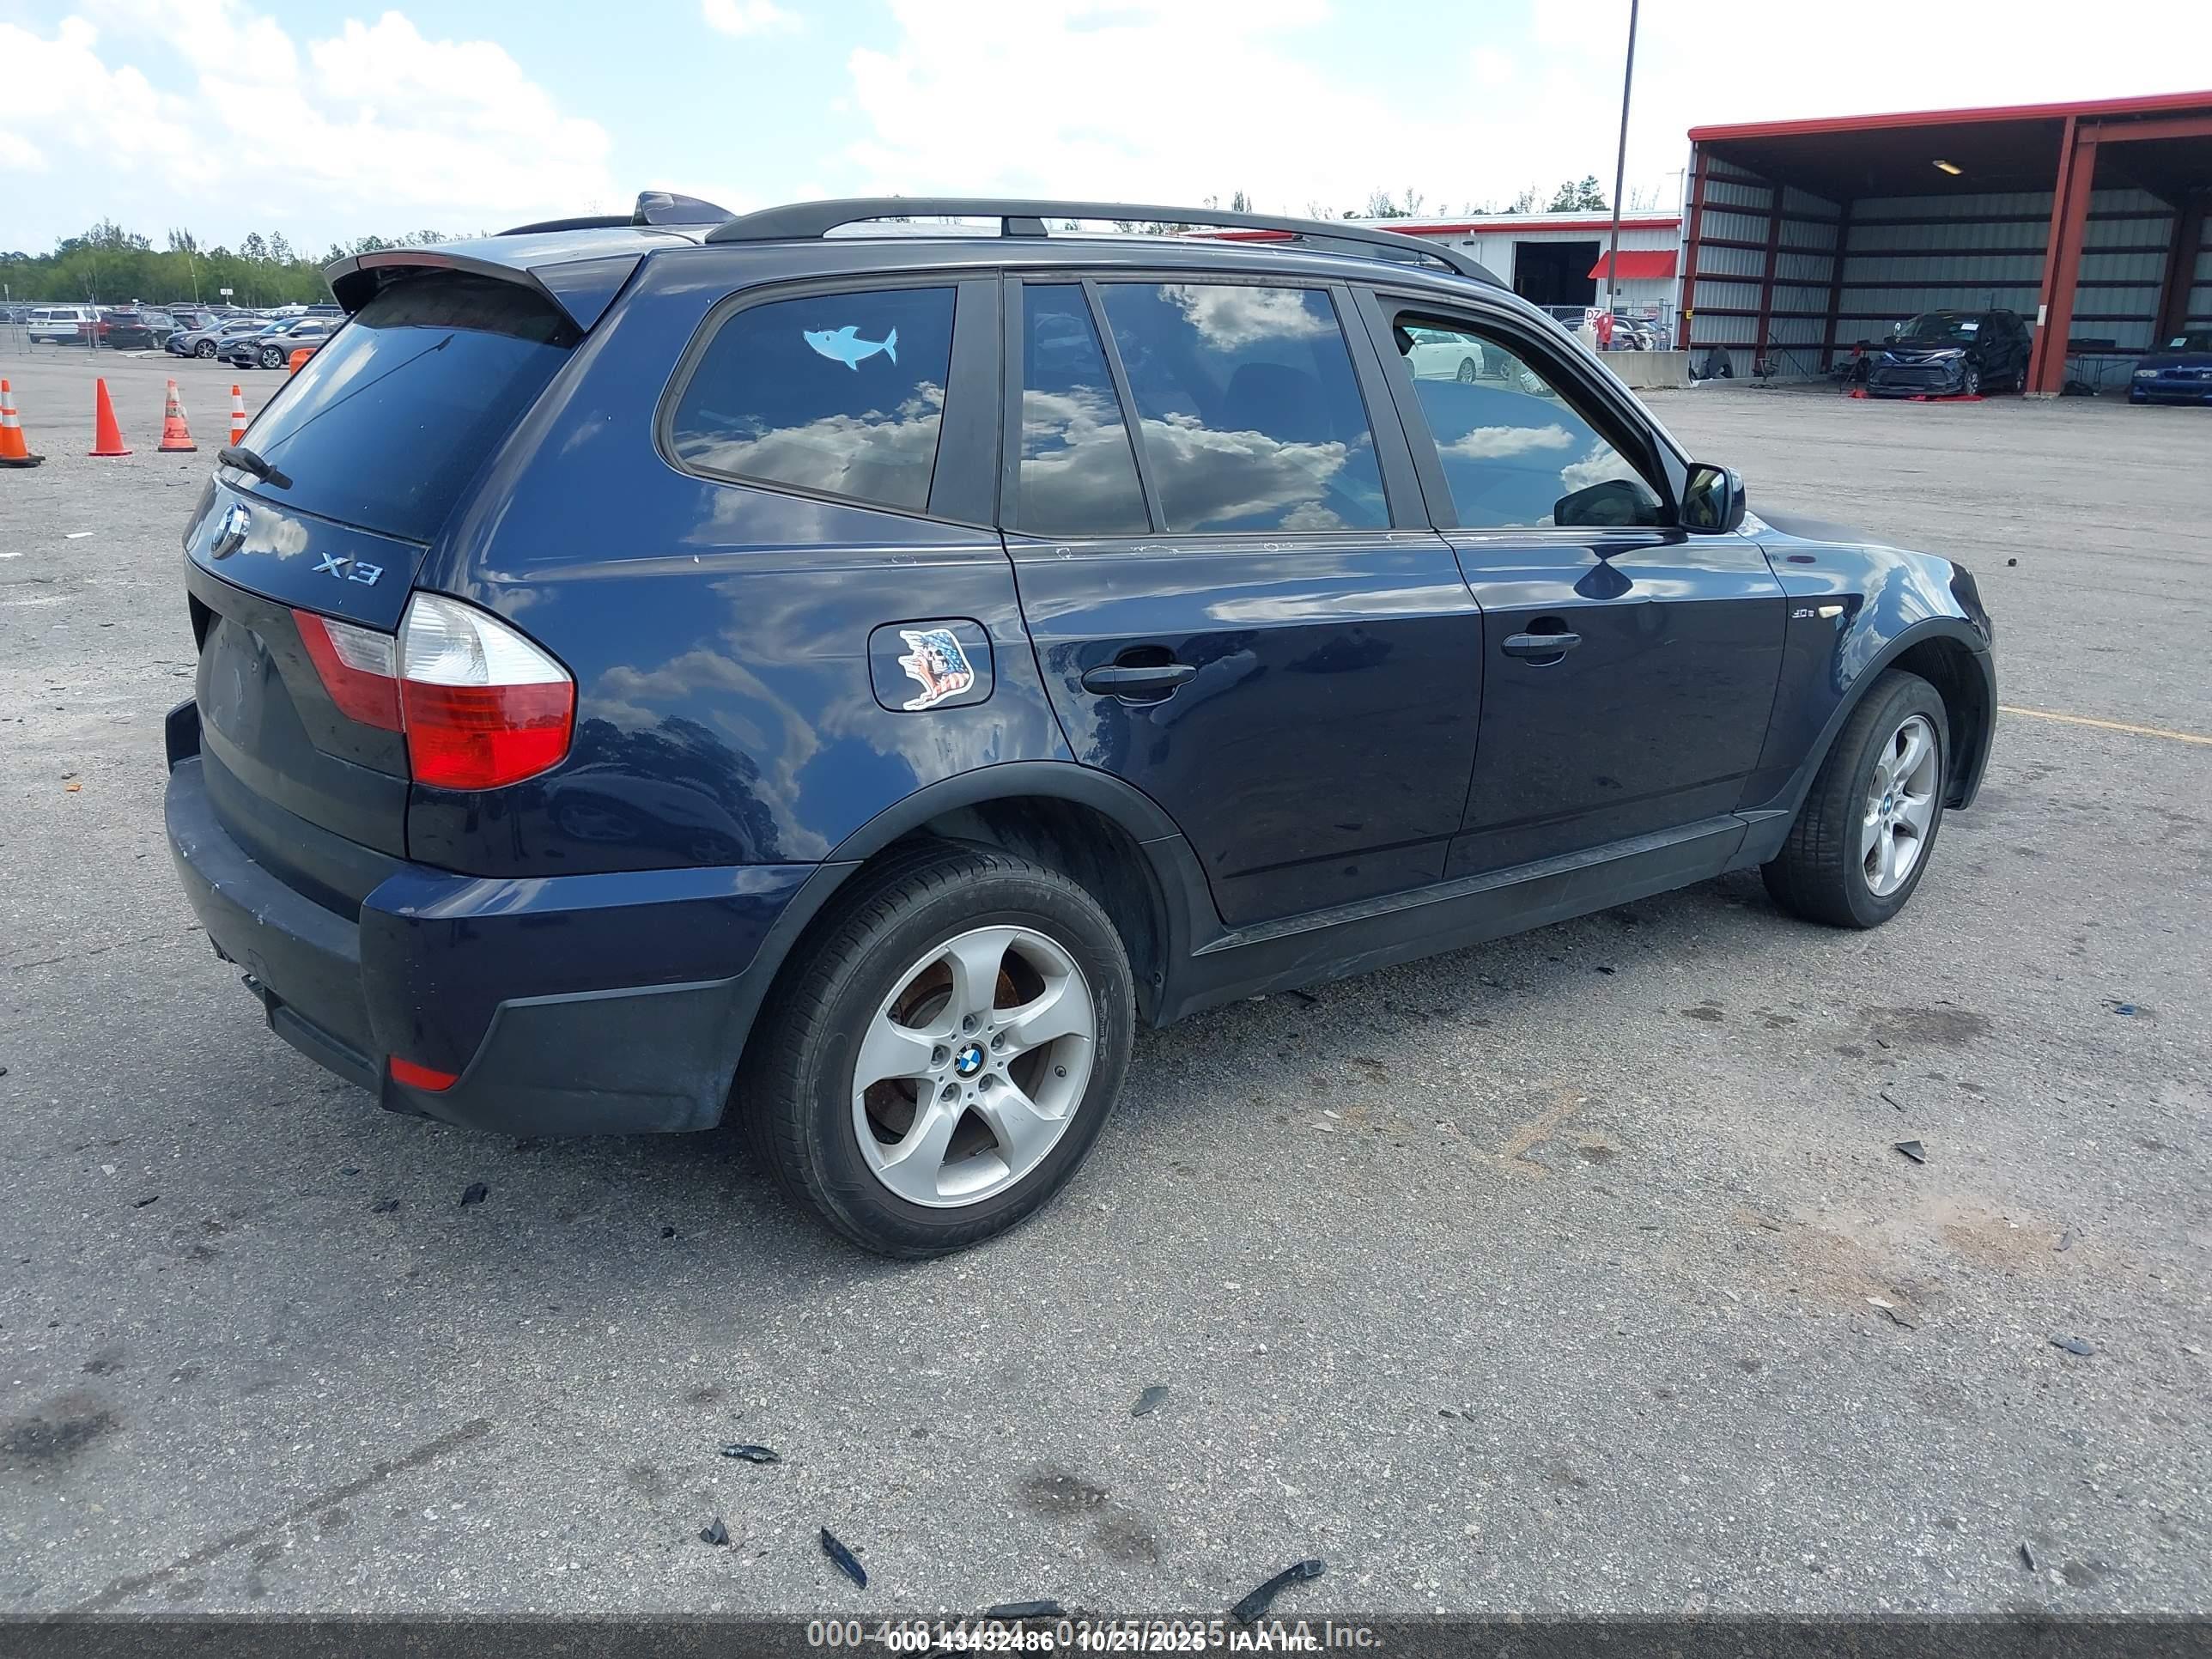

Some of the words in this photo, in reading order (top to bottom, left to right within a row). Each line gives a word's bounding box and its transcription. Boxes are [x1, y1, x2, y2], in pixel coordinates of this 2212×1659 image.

[1587, 310, 1601, 320] DZ
[311, 552, 383, 586] X3
[955, 1042, 972, 1072] BMW
